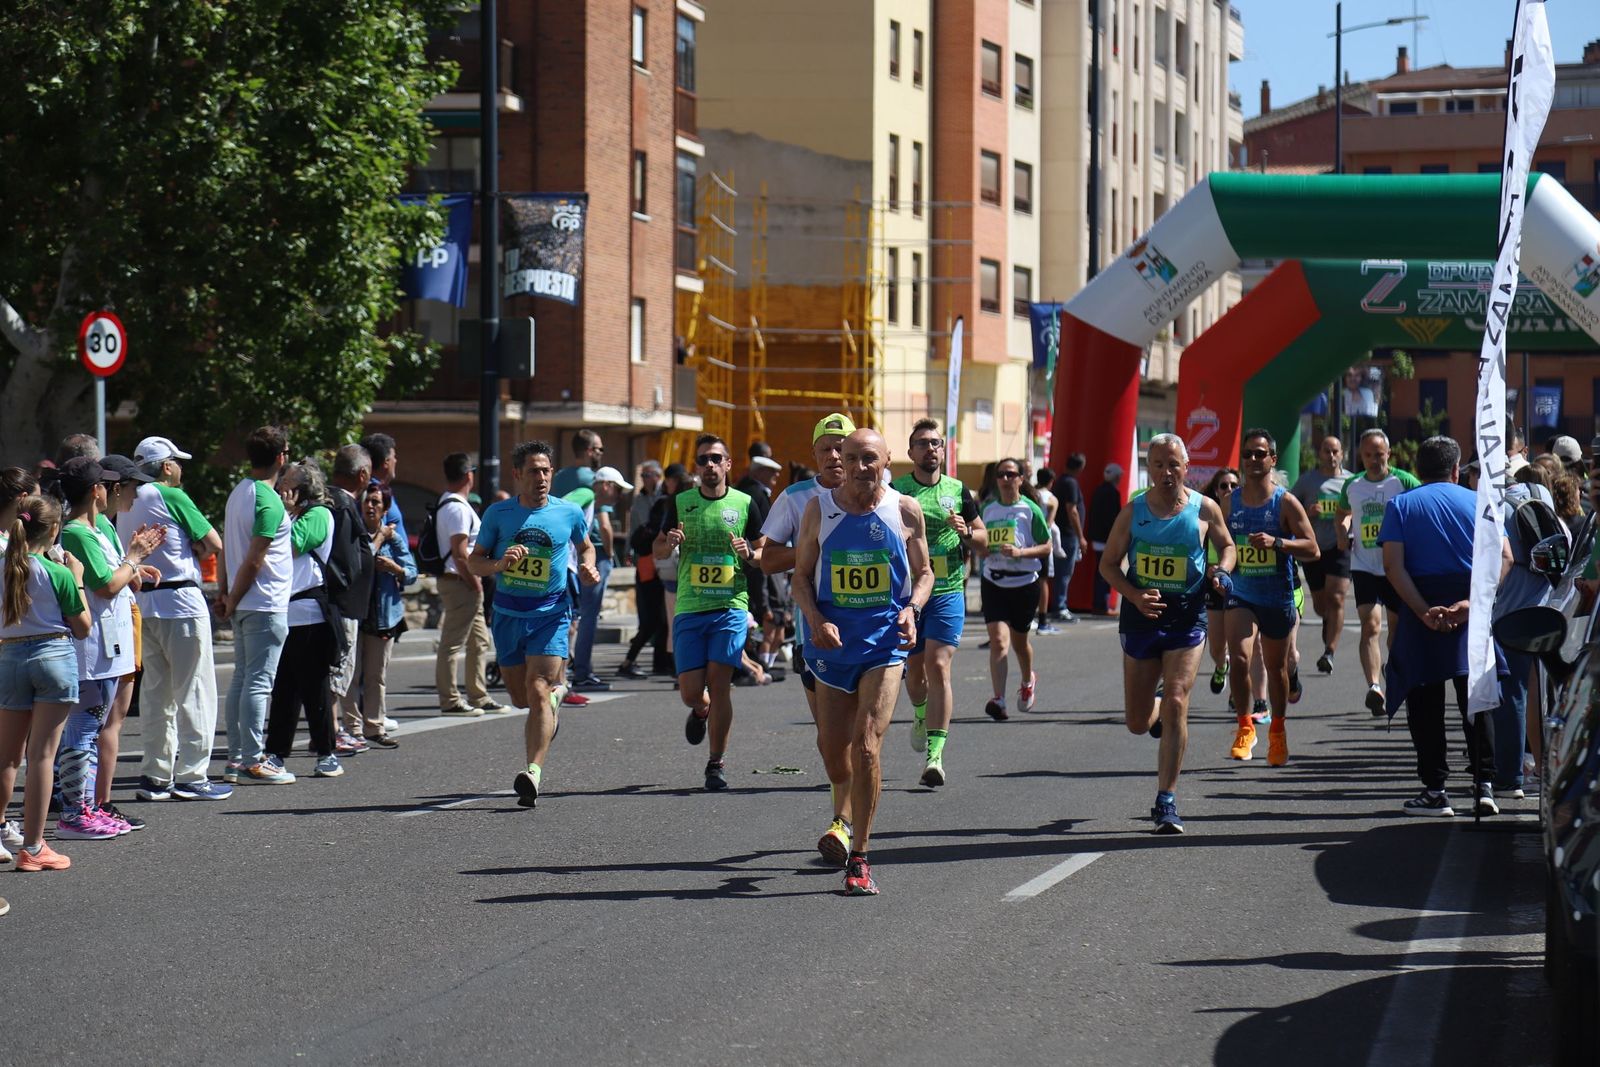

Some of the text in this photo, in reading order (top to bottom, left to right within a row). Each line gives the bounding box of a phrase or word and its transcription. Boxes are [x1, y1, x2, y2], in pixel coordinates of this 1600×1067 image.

[1143, 260, 1206, 319] AYUNTAMIENTO
[1166, 269, 1214, 311] ZAMORA
[1417, 288, 1555, 316] ZAMRA
[90, 333, 117, 354] 30
[988, 528, 1009, 543] 102
[1238, 547, 1267, 564] 120
[699, 566, 722, 584] 82
[1141, 556, 1175, 577] 116
[835, 567, 879, 590] 160
[866, 595, 888, 603] RURAL
